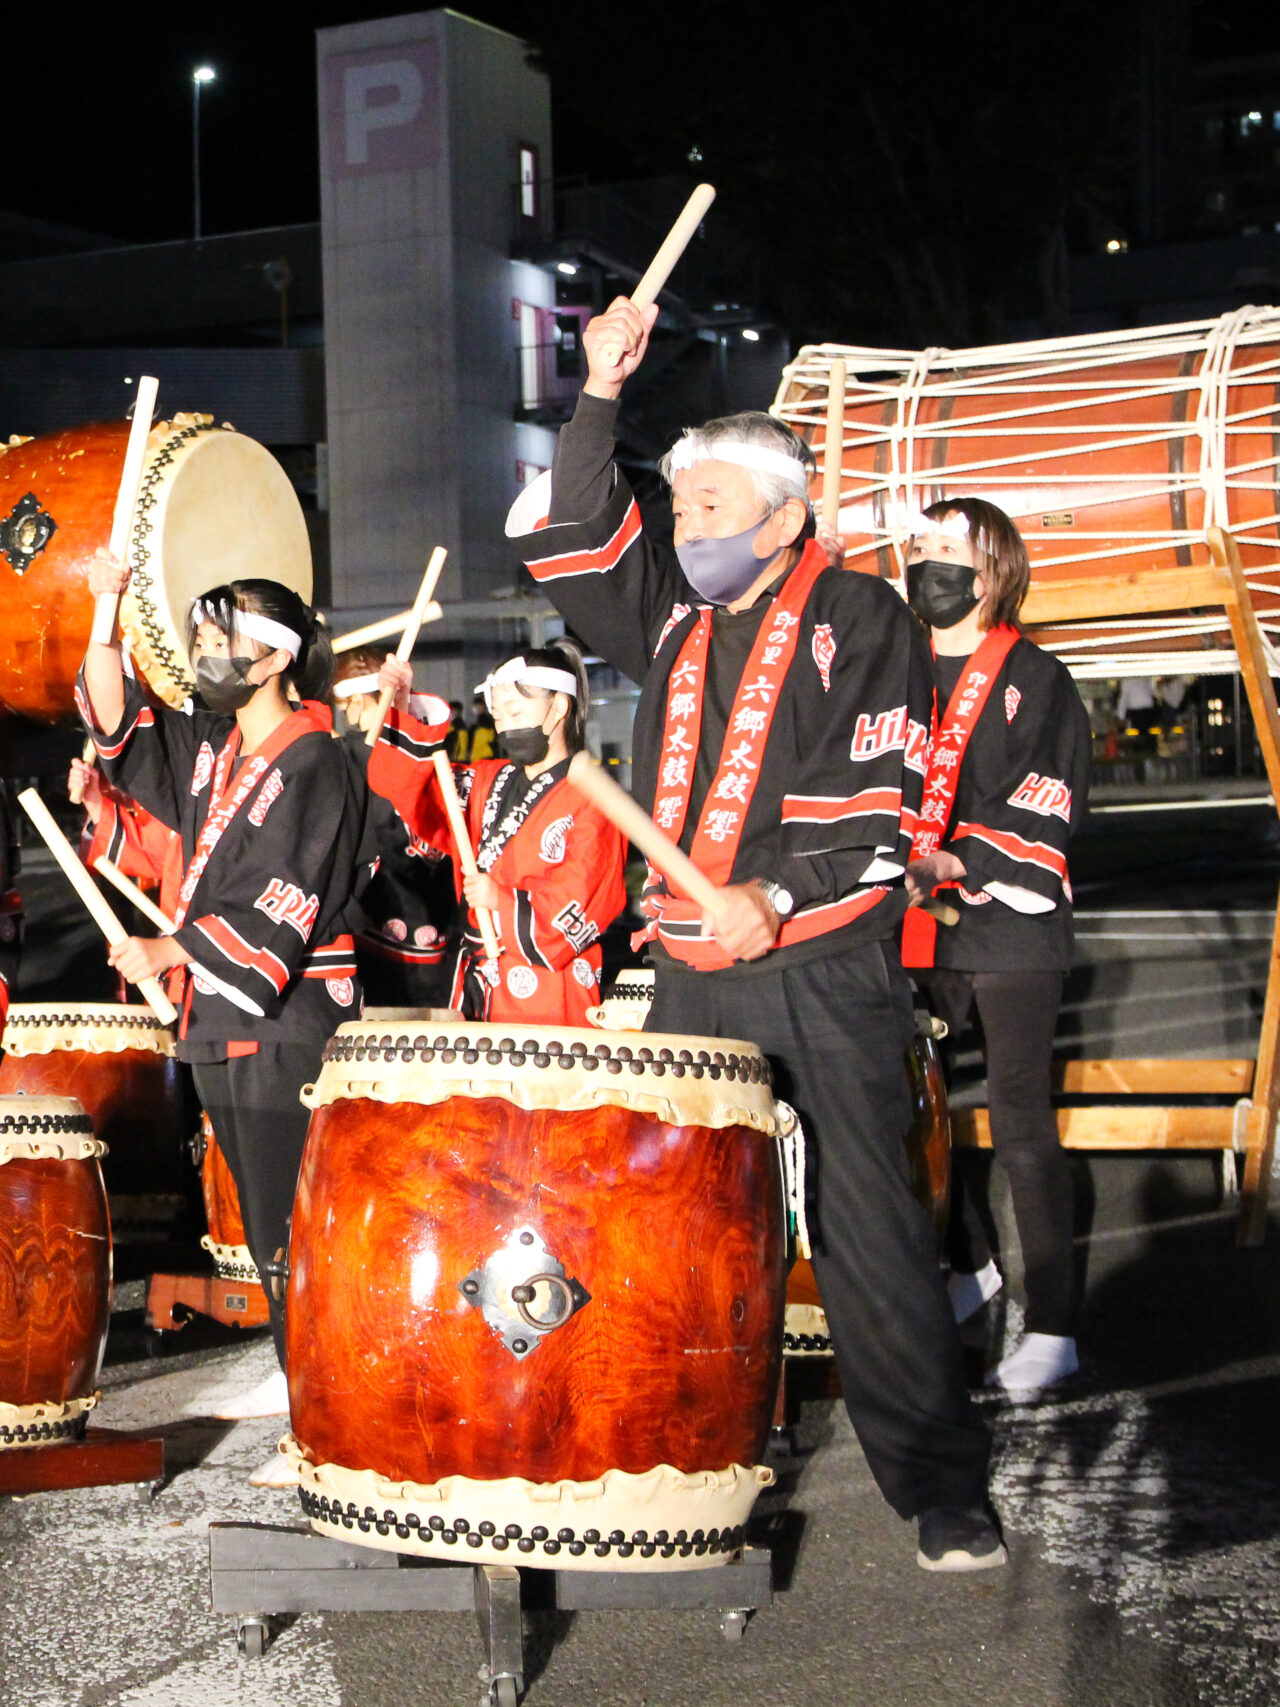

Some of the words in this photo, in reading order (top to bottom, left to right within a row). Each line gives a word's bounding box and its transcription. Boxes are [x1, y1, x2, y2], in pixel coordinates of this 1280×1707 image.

[344, 60, 423, 165] P
[761, 611, 799, 666] 印の里
[661, 660, 699, 788] 六郷太鼓
[956, 671, 989, 717] 印の里
[232, 755, 270, 805] 印の里
[714, 676, 776, 804] 六郷太鼓
[918, 722, 968, 827] 六郷太鼓
[524, 772, 554, 804] 印の里
